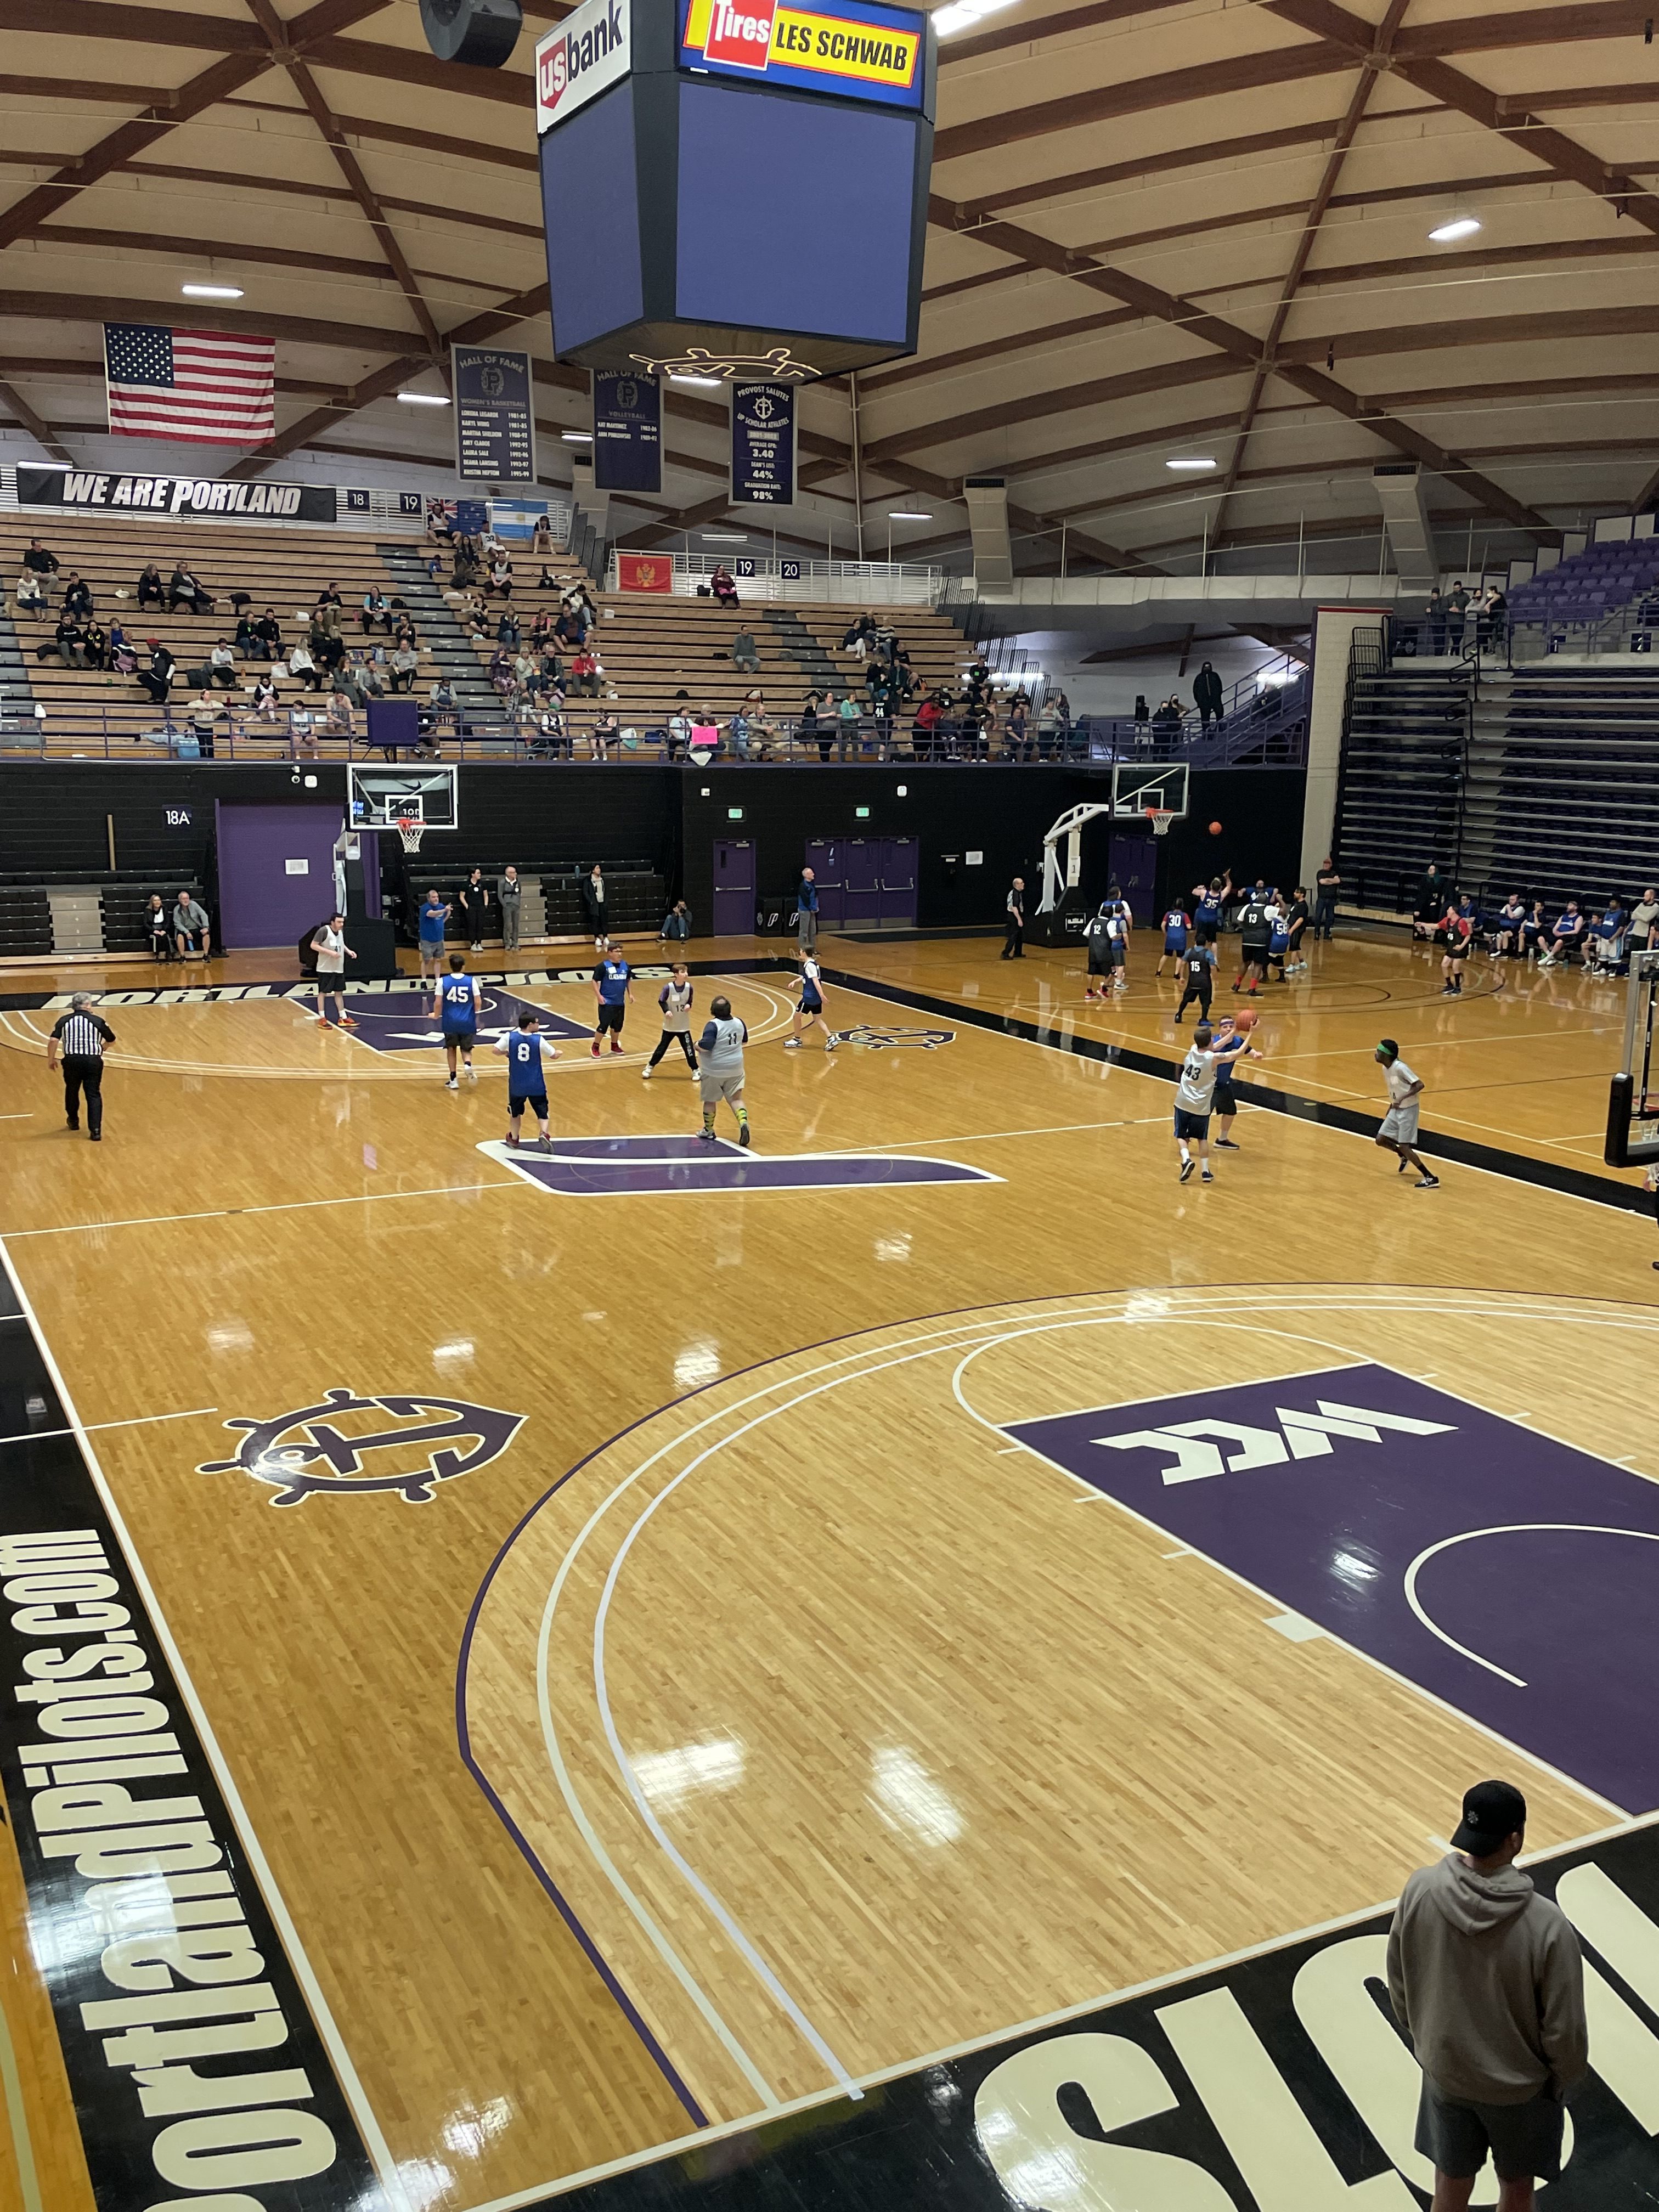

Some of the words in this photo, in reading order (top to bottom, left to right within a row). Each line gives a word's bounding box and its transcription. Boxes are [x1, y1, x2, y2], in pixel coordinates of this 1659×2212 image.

[713, 0, 770, 43] Tires
[776, 22, 812, 53] LES
[816, 31, 909, 71] SCHWAB
[459, 356, 482, 369] HALL
[484, 356, 497, 364] OF
[499, 358, 525, 373] FAME
[597, 369, 618, 381] HALL
[737, 386, 765, 398] PROVOST
[766, 386, 790, 402] SALUTES
[745, 417, 767, 428] SCHOLAR
[768, 416, 789, 428] ATHLETES
[752, 449, 774, 459] 3.40
[753, 470, 774, 479] 44%
[63, 473, 110, 504] WE
[111, 477, 170, 507] ARE
[170, 479, 301, 514] PORTLAND
[753, 490, 774, 500] 98%
[352, 494, 364, 506] 18
[404, 496, 418, 510] 19
[740, 561, 753, 574] 19
[783, 565, 798, 577] 20
[876, 707, 884, 718] 44
[166, 810, 190, 825] 18A
[1204, 899, 1218, 909] 35
[1169, 915, 1181, 927] 30
[1248, 913, 1257, 924] 13
[1093, 924, 1101, 934] 12
[1190, 961, 1200, 972] 15
[446, 986, 469, 1003] 45
[728, 1032, 737, 1045] 11
[517, 1043, 530, 1062] 8
[1185, 1064, 1201, 1081] 43
